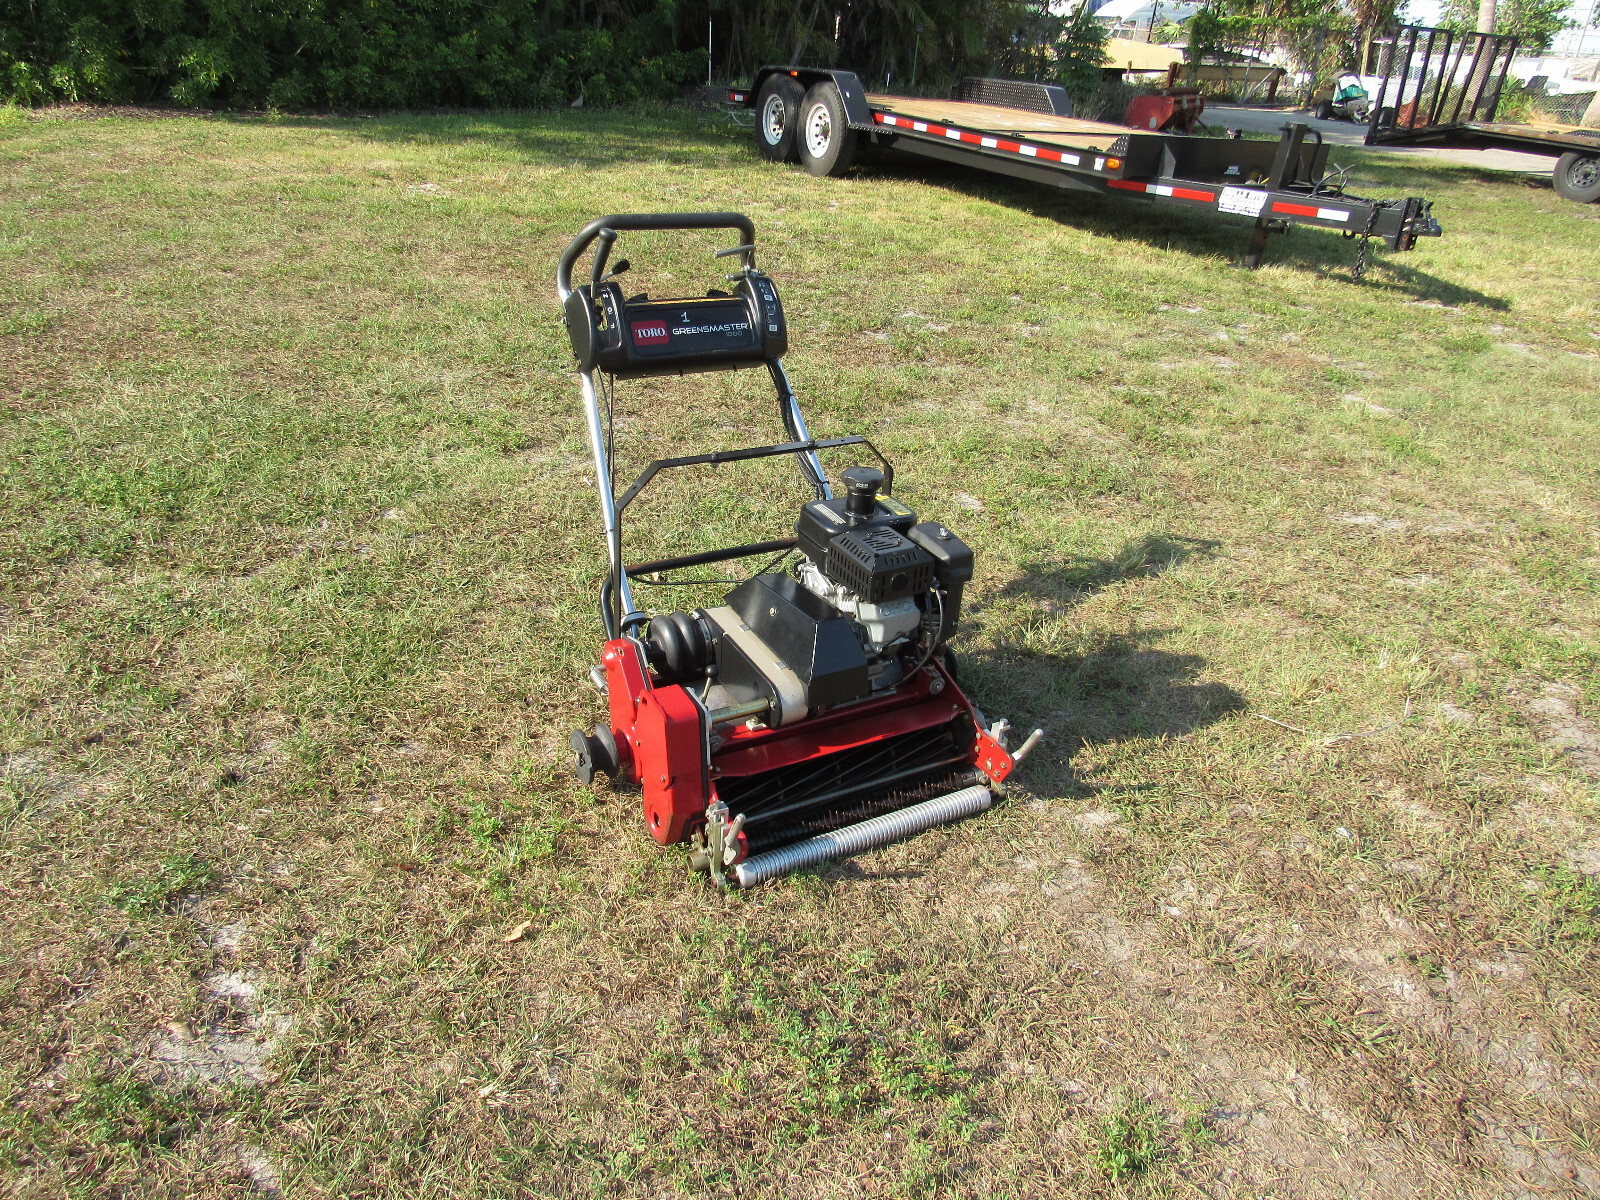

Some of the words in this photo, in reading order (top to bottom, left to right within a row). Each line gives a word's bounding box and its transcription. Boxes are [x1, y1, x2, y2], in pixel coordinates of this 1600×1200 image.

[680, 311, 690, 323] 1
[635, 326, 667, 339] TORO
[672, 322, 748, 336] GREENSMASTER
